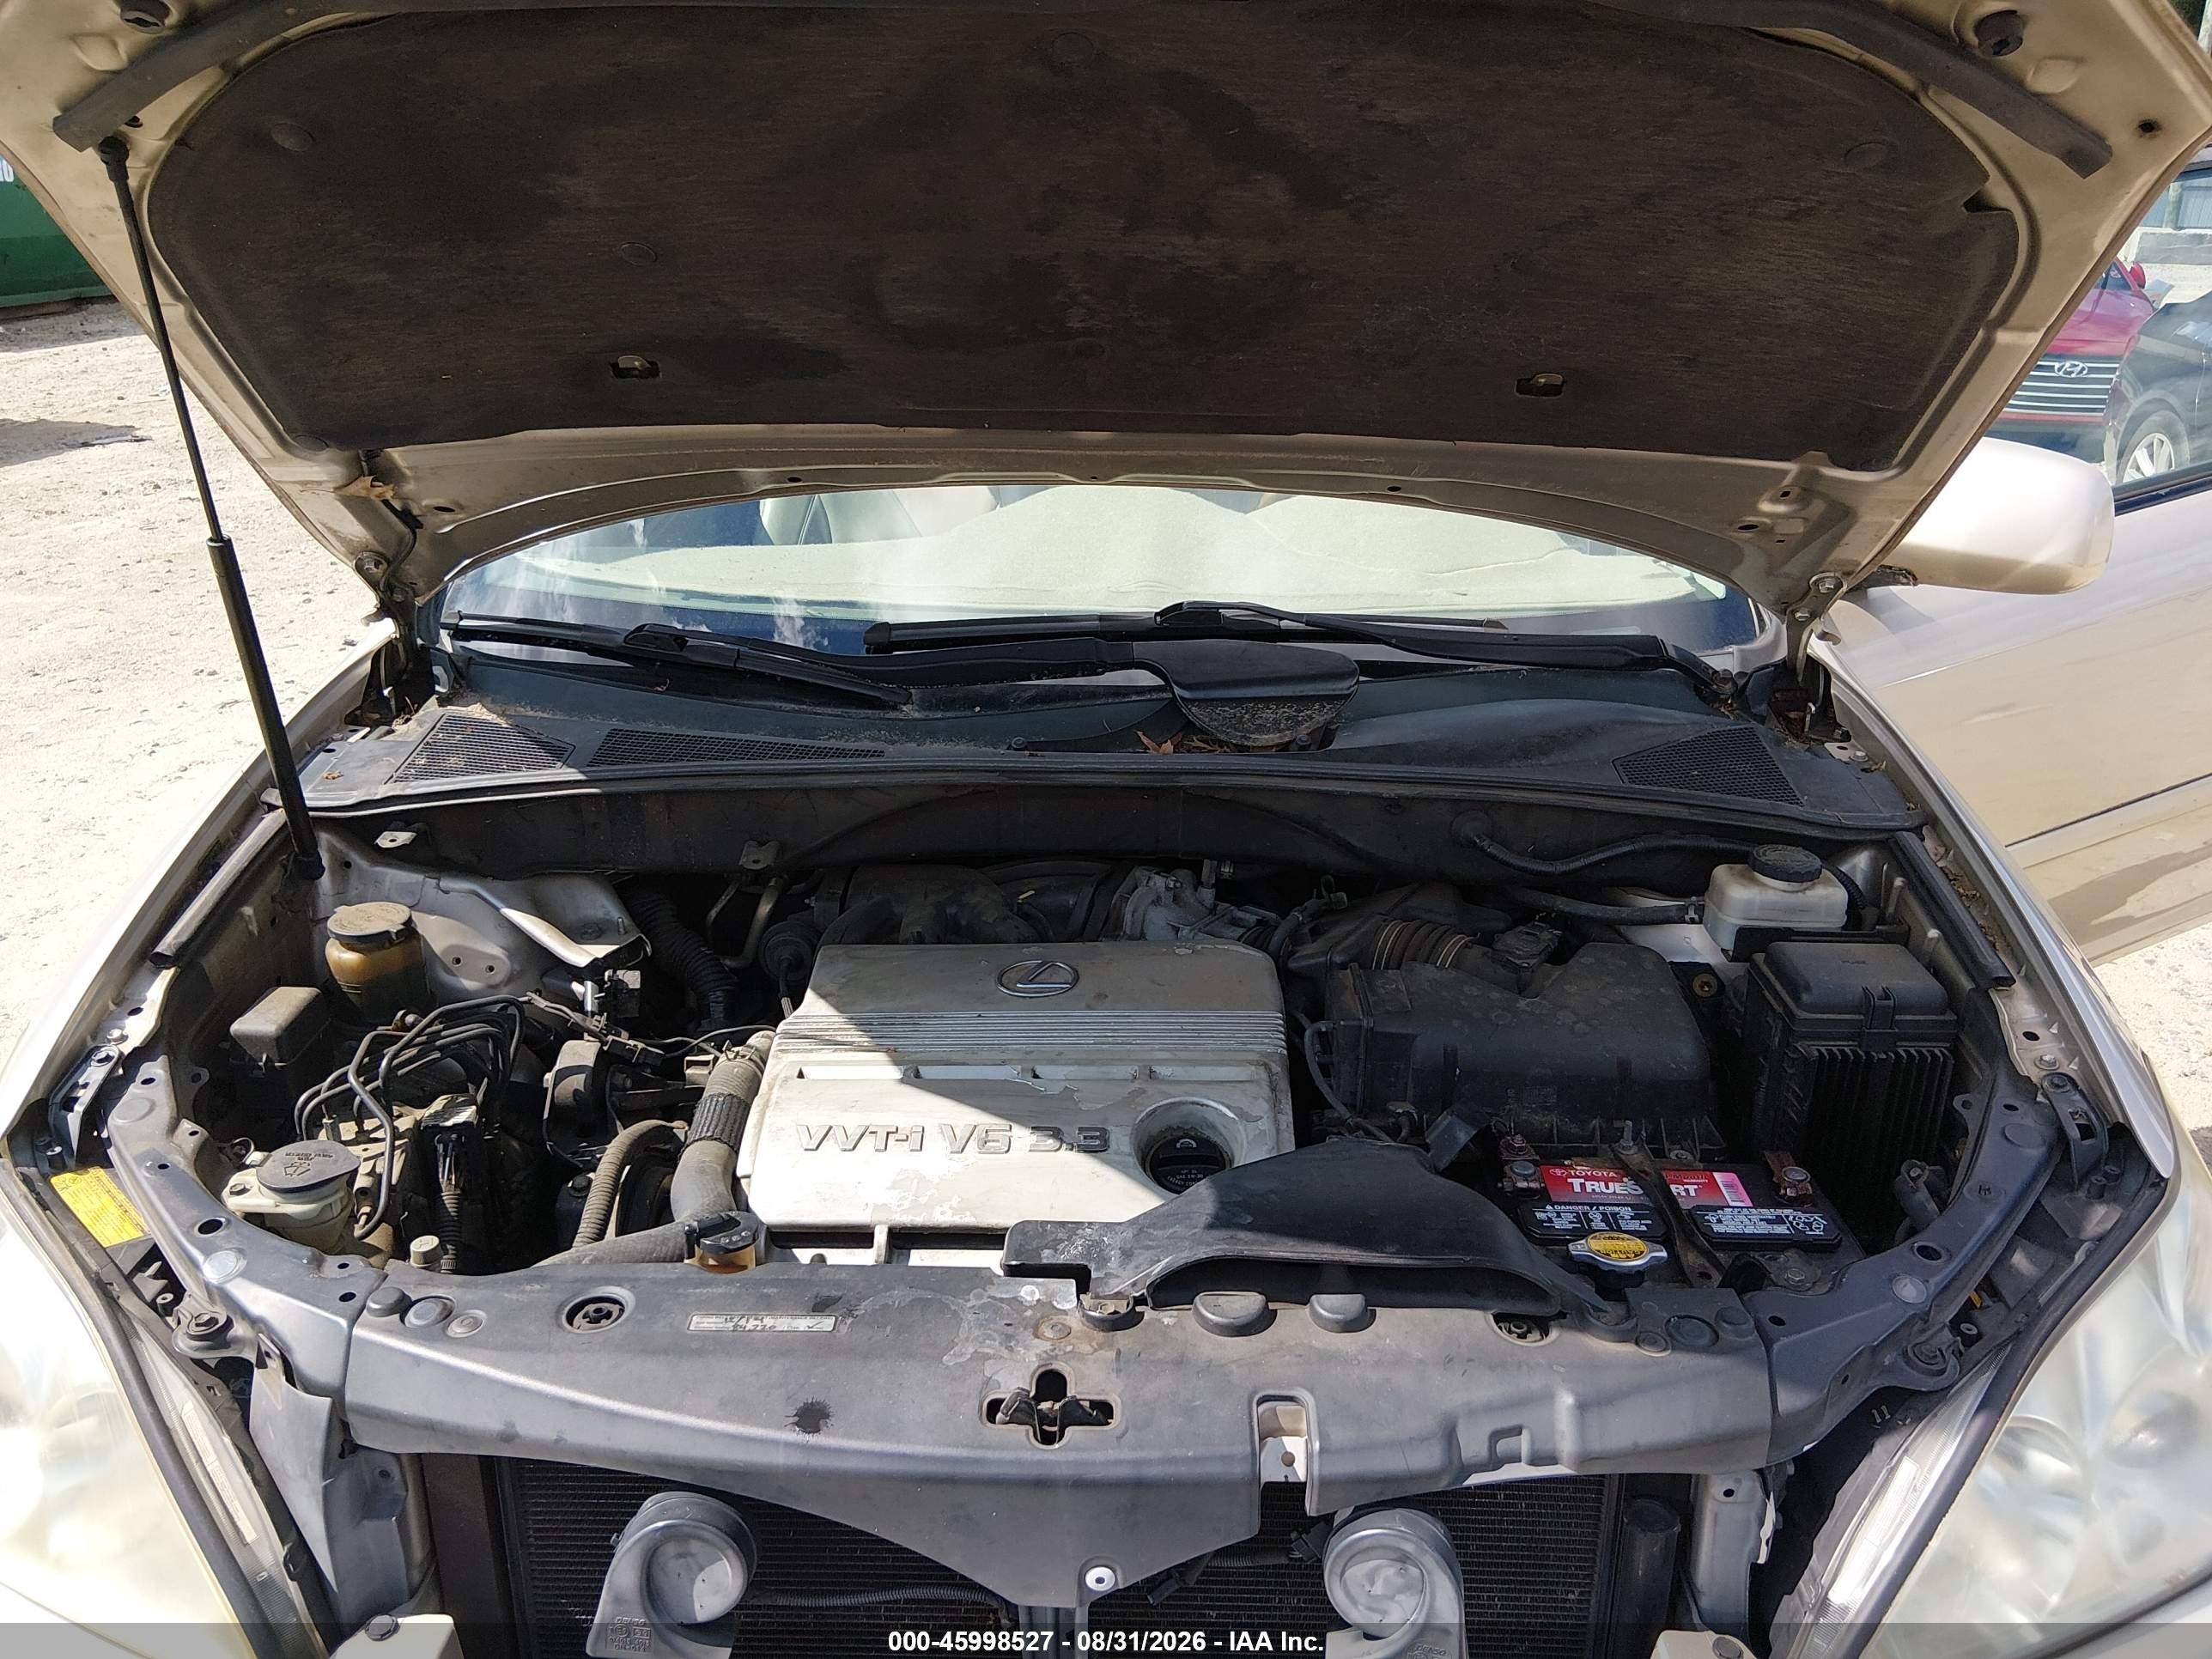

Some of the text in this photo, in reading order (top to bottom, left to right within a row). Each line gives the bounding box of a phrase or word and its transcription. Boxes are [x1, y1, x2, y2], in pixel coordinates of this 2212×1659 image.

[941, 1124, 1012, 1154] V6
[1028, 1126, 1110, 1153] 3.3
[1569, 1169, 1618, 1177] TOYOTA
